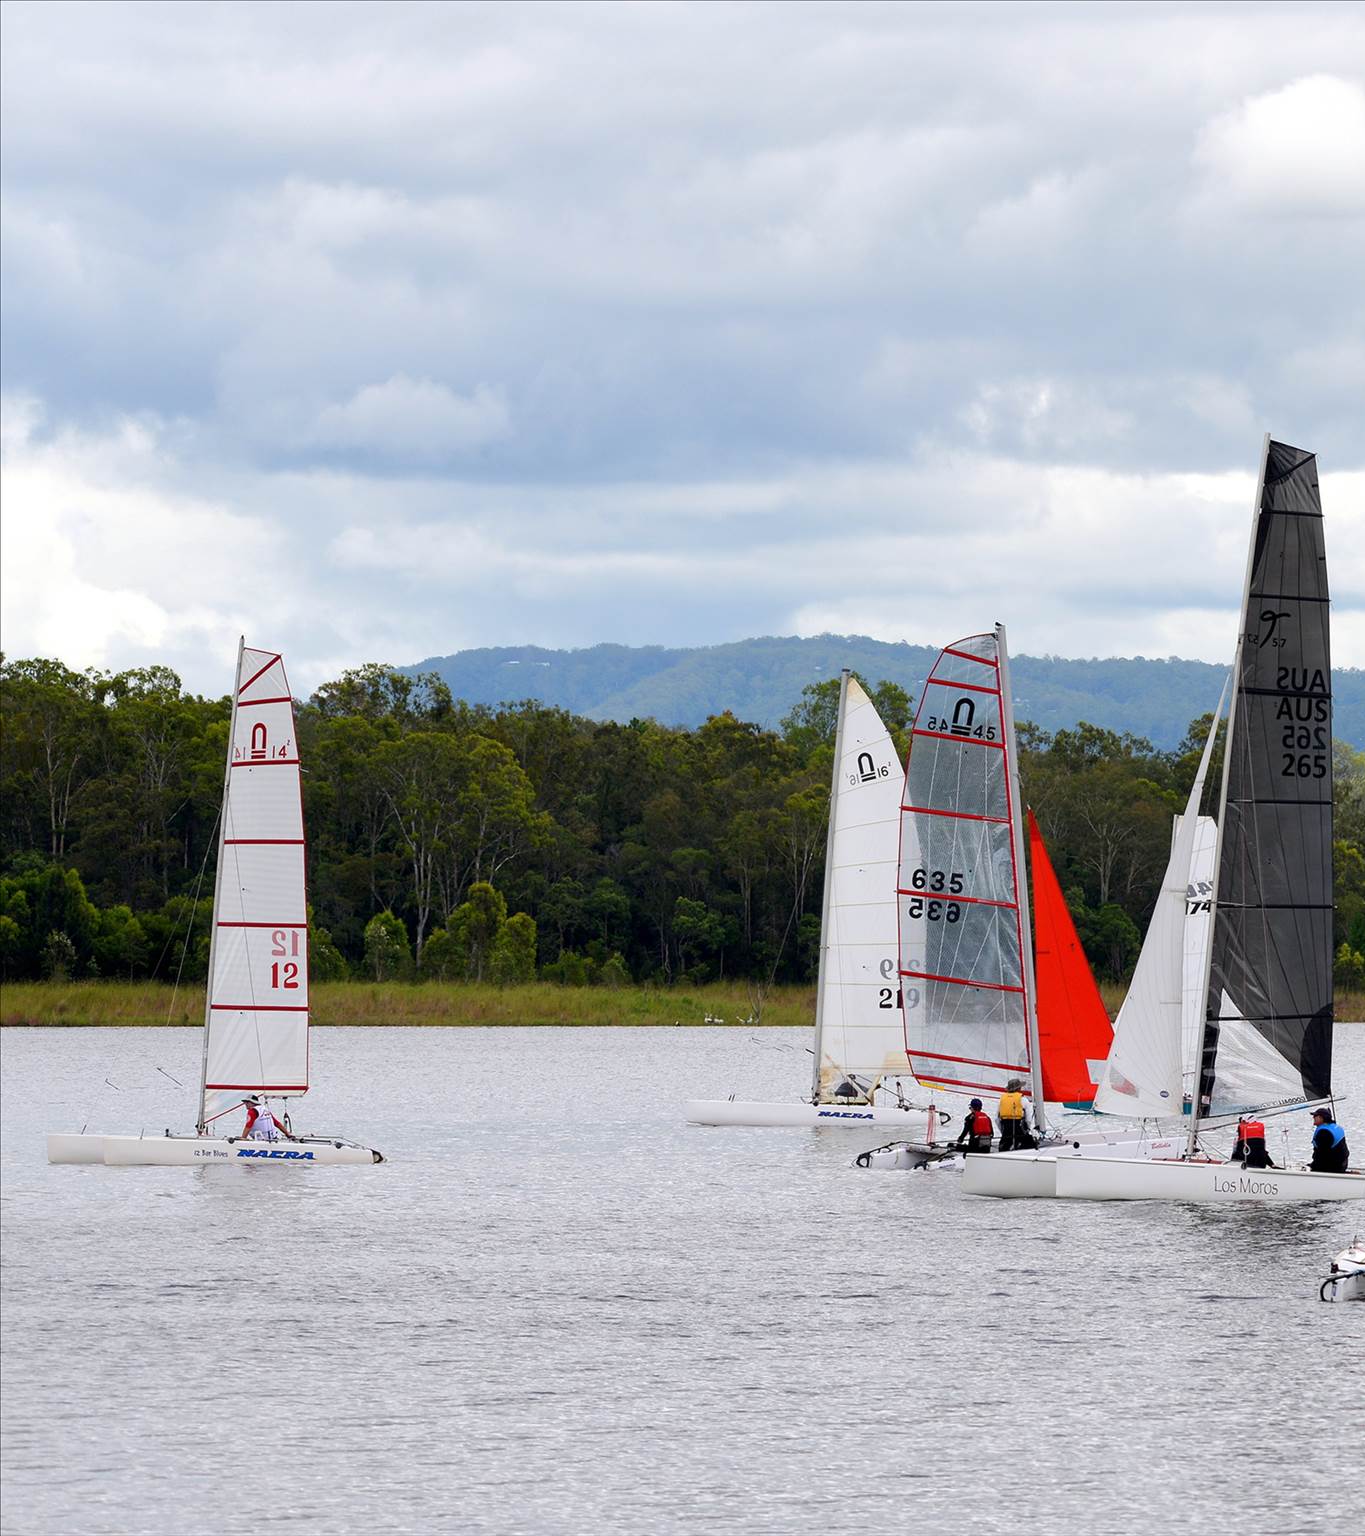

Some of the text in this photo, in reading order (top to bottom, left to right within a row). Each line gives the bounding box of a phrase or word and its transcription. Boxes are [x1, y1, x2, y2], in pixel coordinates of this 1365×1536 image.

[1276, 697, 1328, 723] AUS
[1281, 753, 1327, 779] 265
[912, 869, 964, 894] 635
[271, 961, 299, 989] 12
[1214, 1176, 1278, 1195] Los Moros
